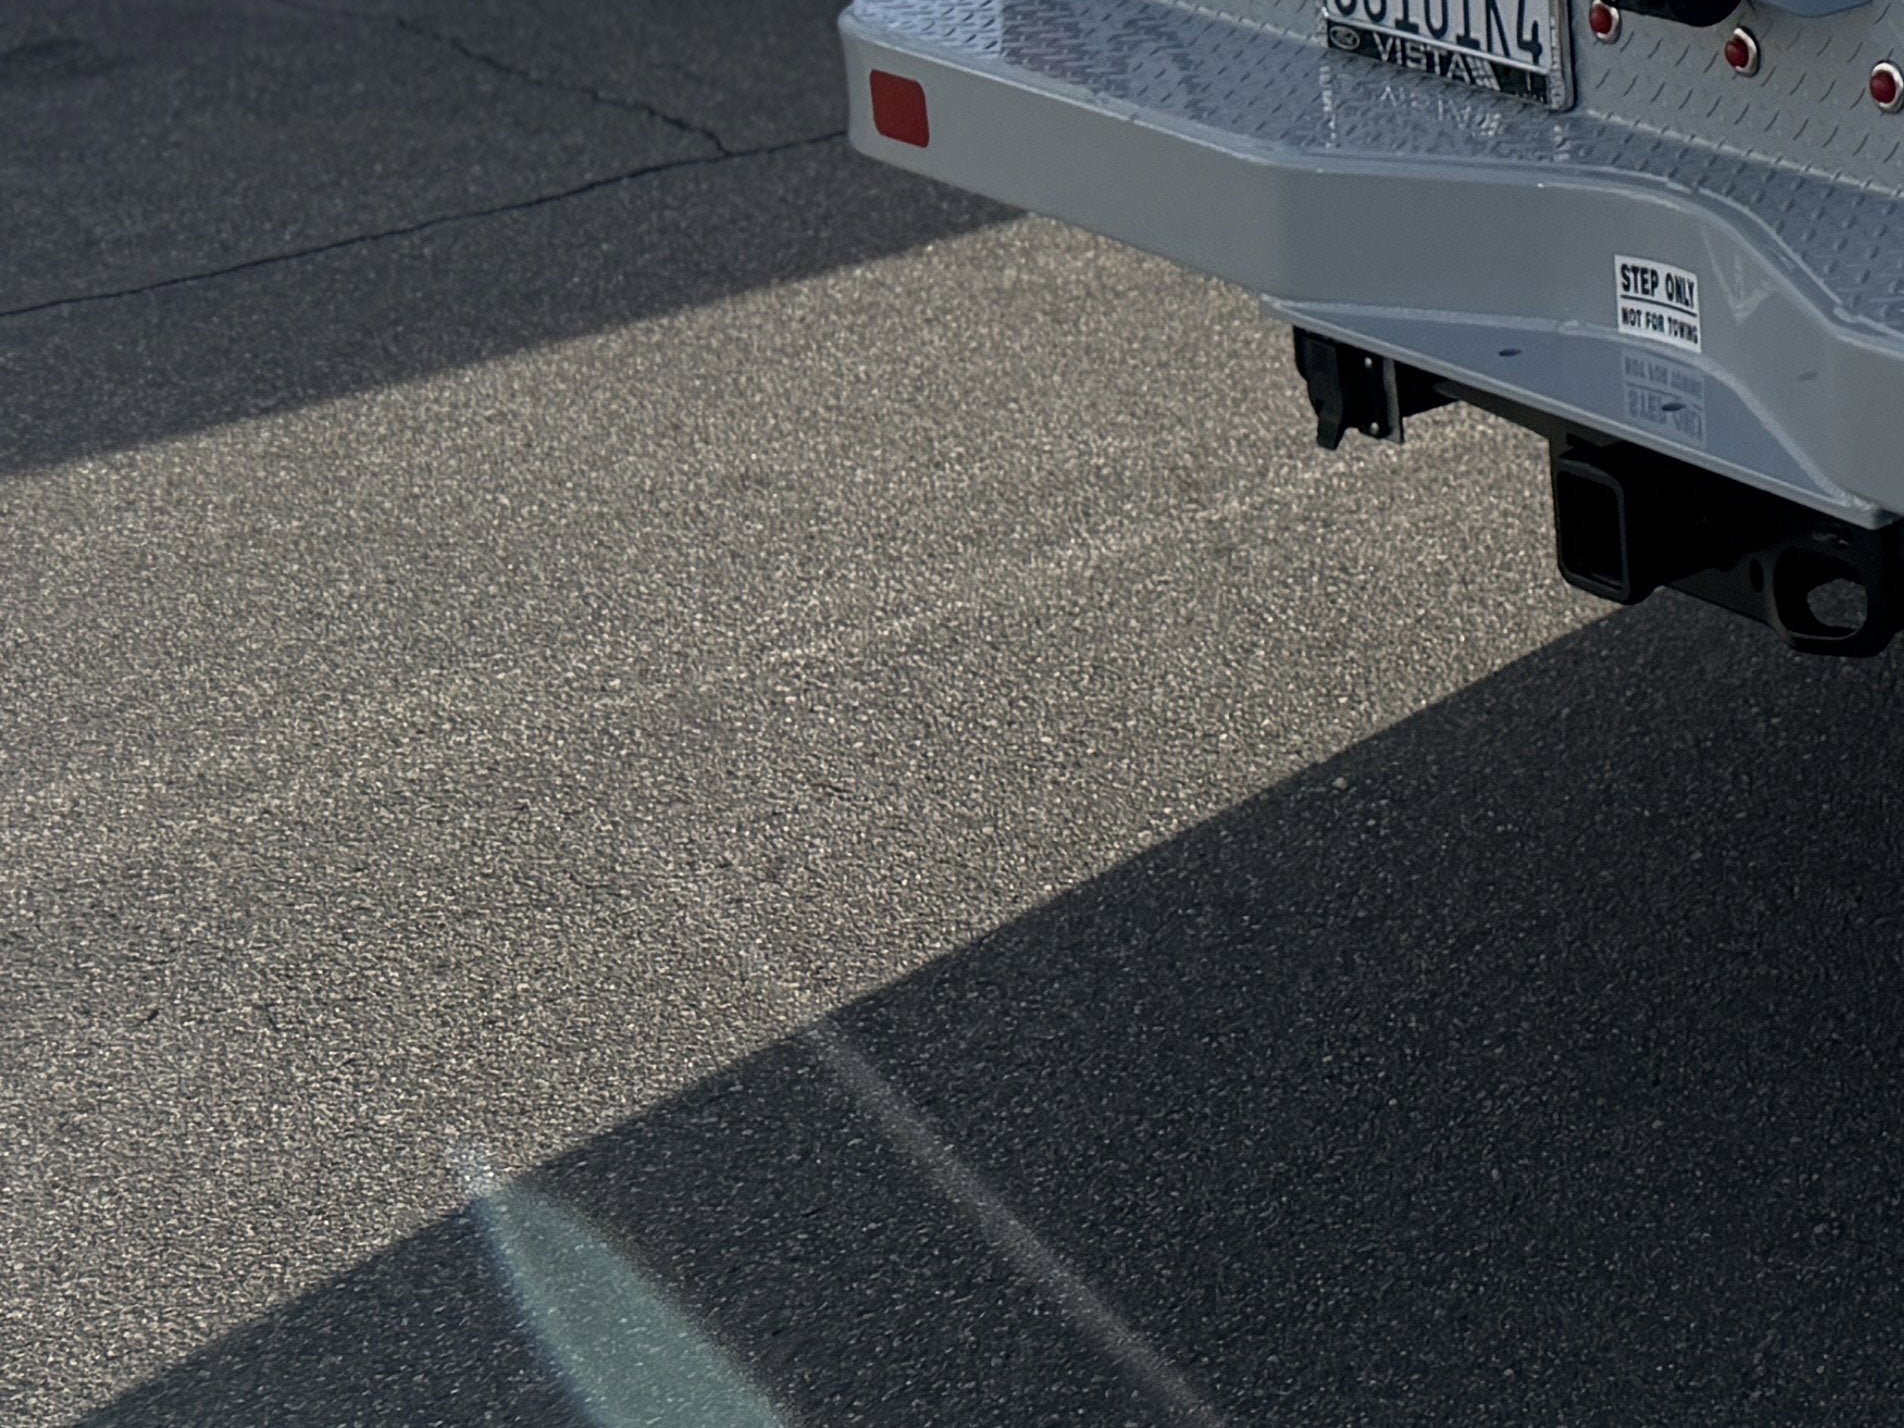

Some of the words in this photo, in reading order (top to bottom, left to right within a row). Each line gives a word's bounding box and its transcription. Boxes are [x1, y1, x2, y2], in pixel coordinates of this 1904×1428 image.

[1372, 33, 1473, 84] VISTA
[1620, 263, 1659, 297] STEP
[1665, 272, 1695, 308] ONLY
[1621, 306, 1642, 328] NOT
[1645, 311, 1665, 333] FOR
